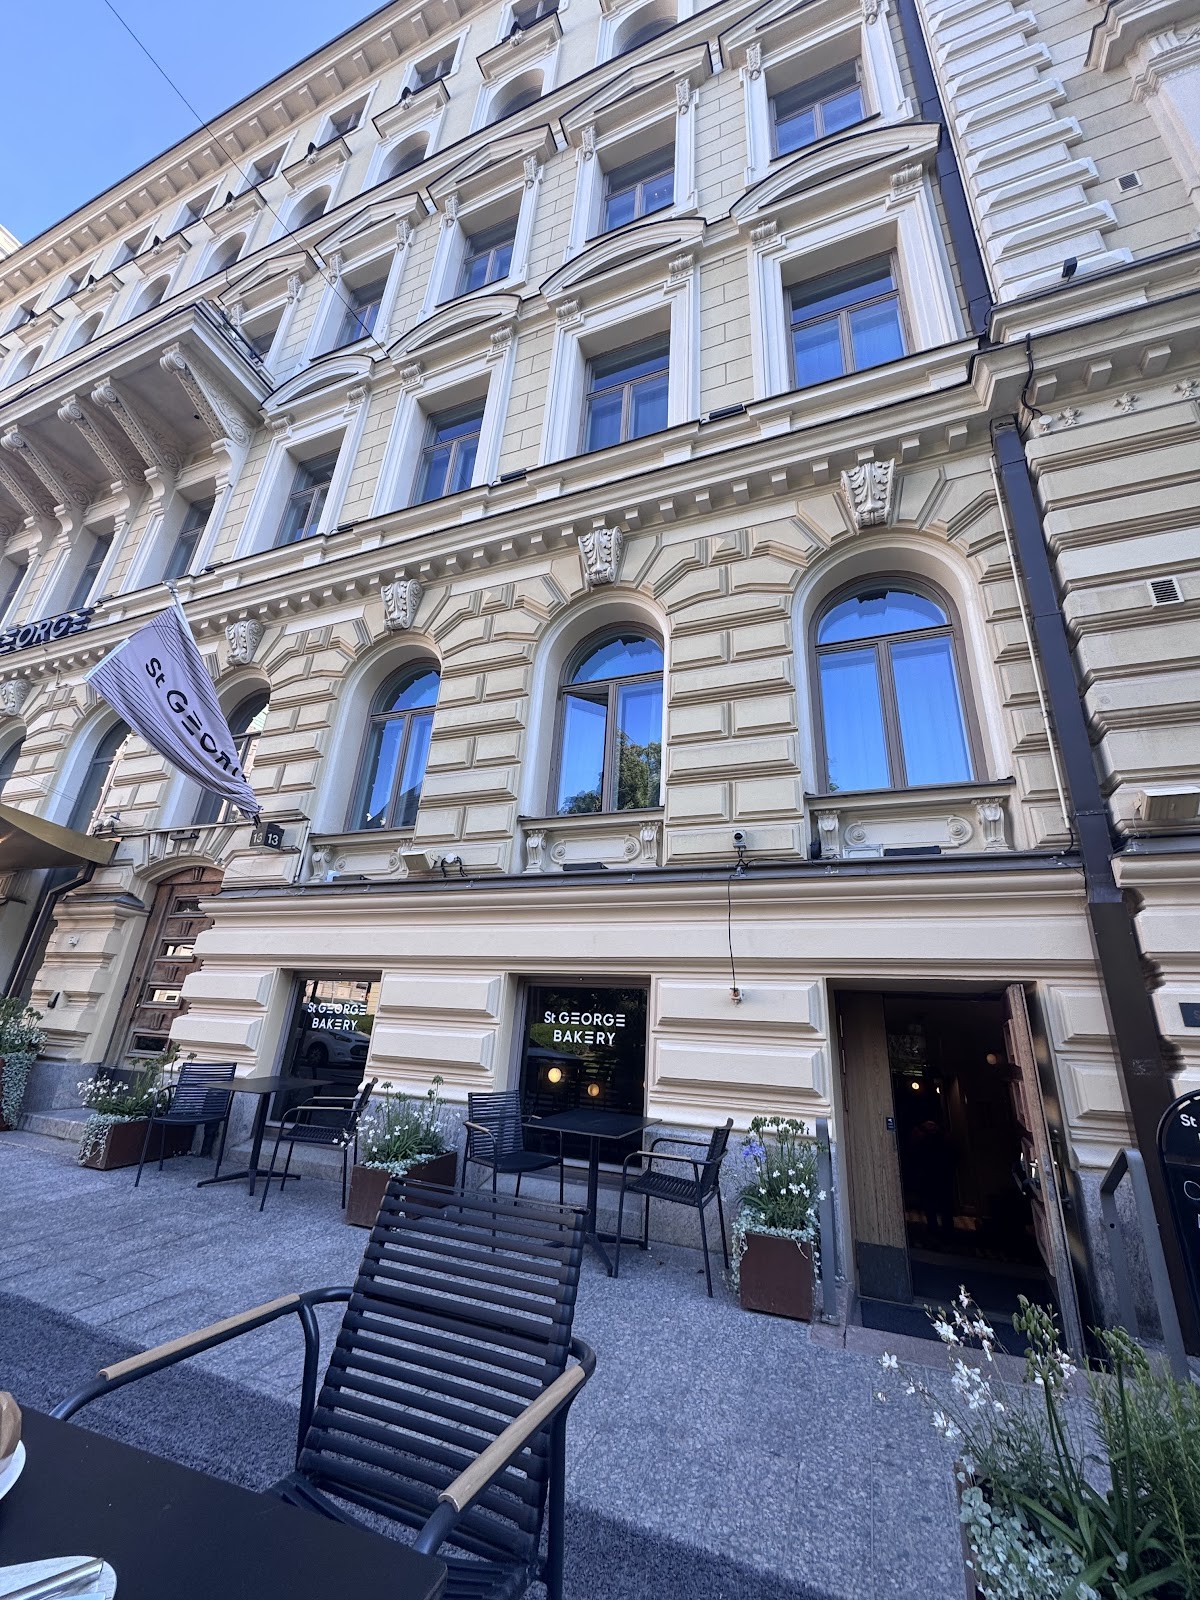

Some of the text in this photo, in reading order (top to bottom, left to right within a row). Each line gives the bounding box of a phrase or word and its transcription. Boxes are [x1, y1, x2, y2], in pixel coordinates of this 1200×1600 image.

[146, 657, 166, 688] St
[253, 832, 263, 843] 13
[267, 833, 279, 845] 13
[307, 1002, 367, 1016] St GEORGE
[311, 1018, 358, 1031] BAKERY
[544, 1011, 625, 1027] St GEORGE
[553, 1030, 616, 1045] BAKERY
[1180, 1113, 1198, 1128] St
